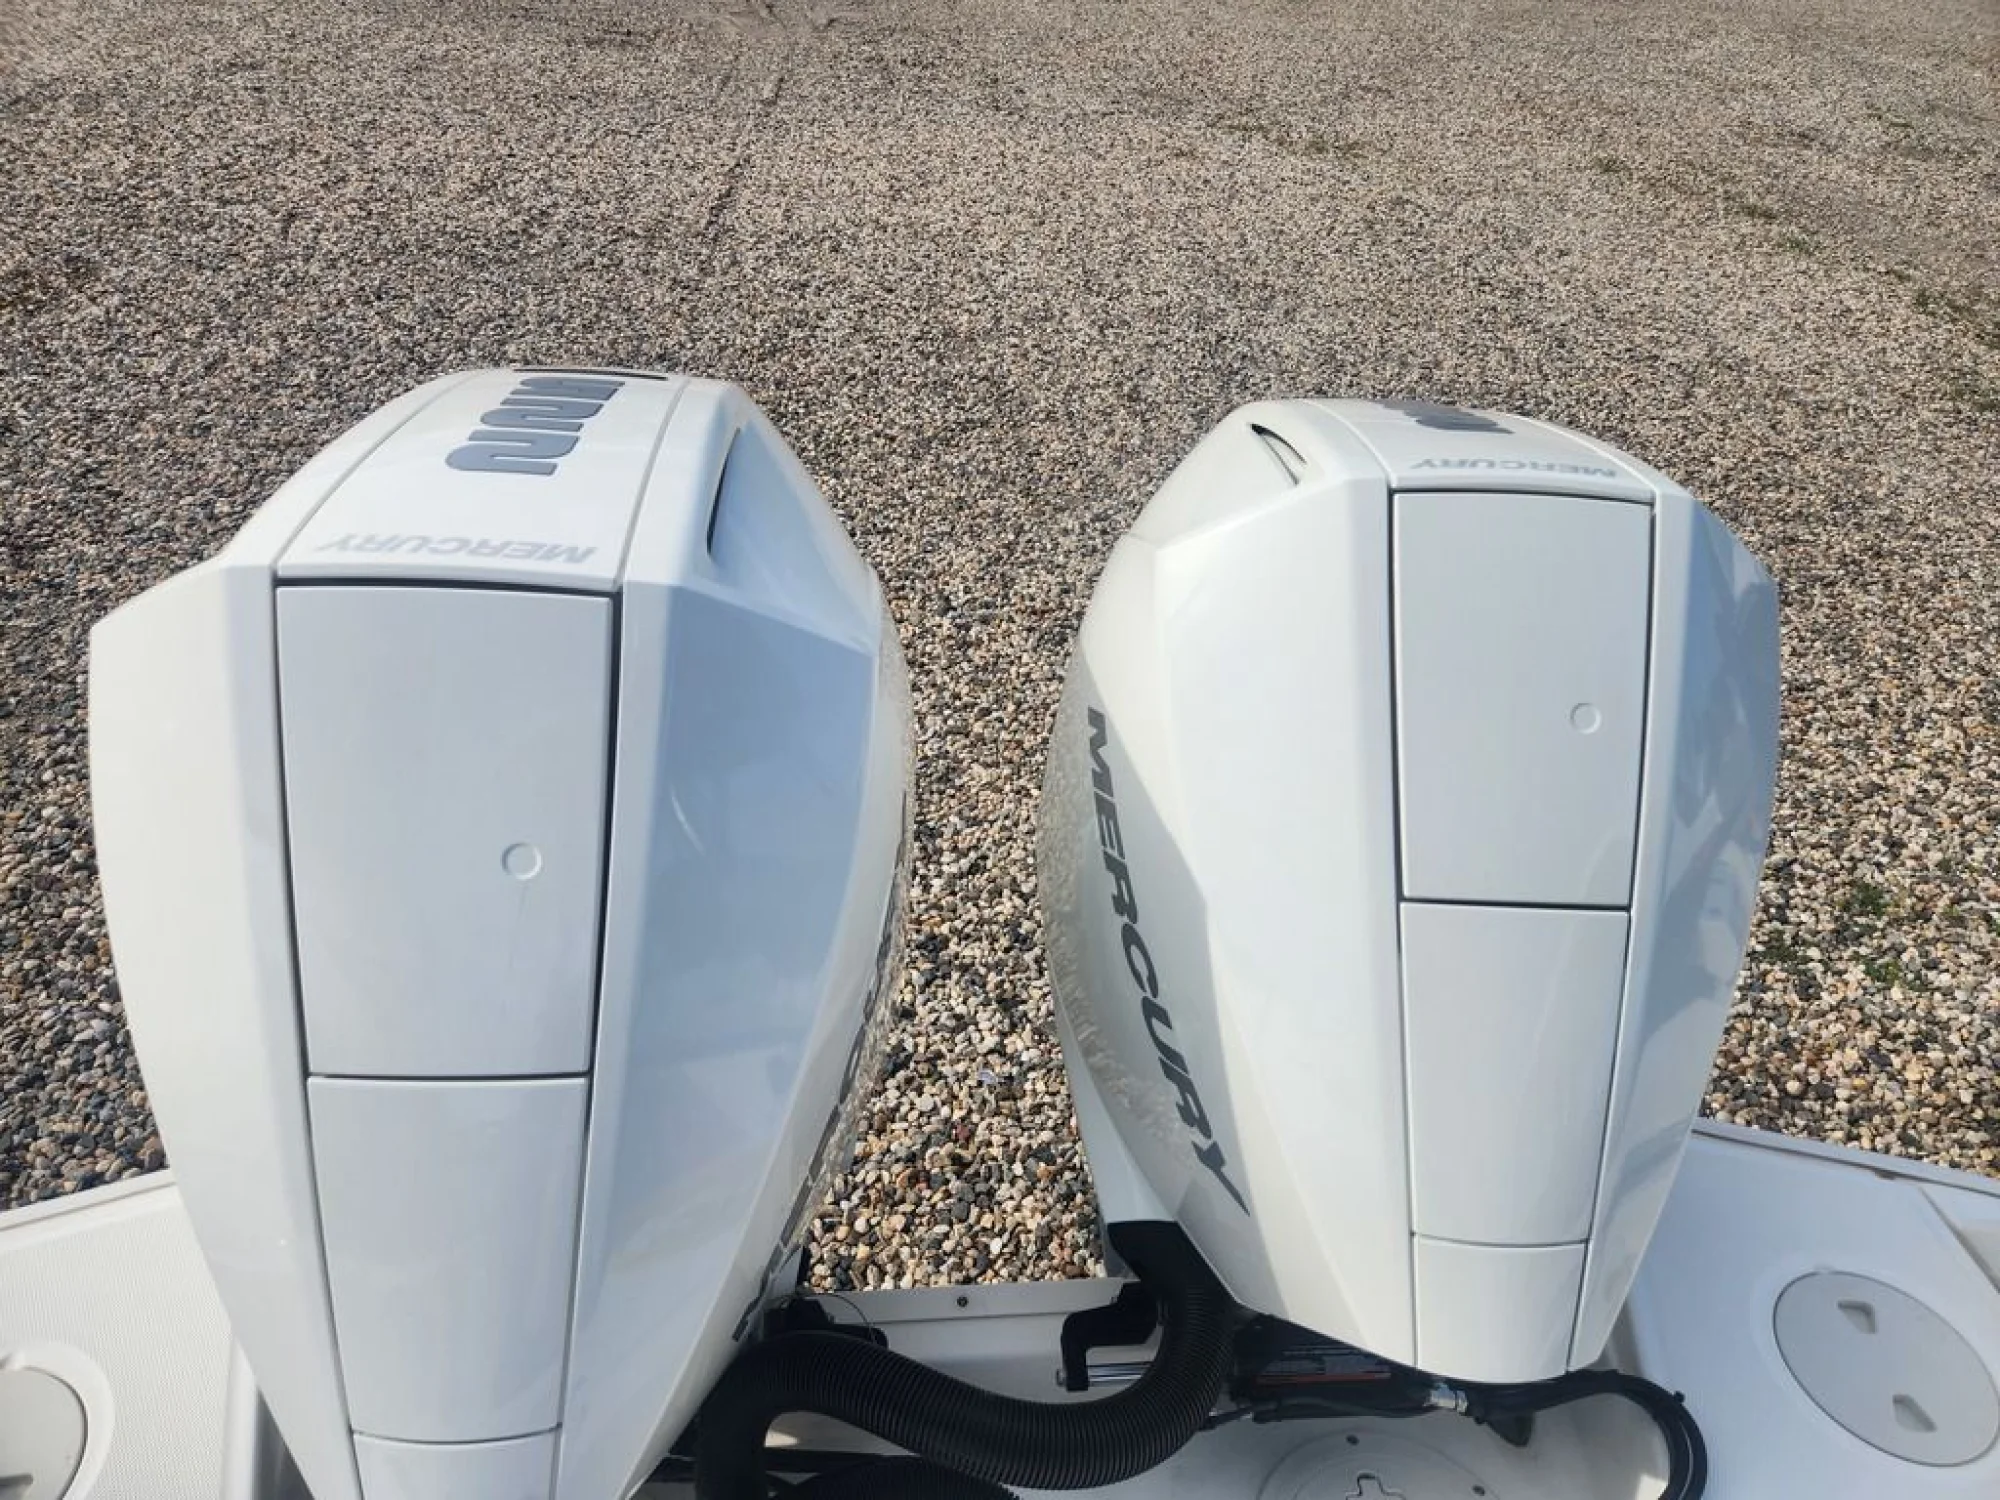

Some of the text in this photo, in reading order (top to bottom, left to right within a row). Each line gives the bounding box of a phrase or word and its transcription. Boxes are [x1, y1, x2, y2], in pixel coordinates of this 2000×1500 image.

[1411, 457, 1616, 477] MERCURY
[317, 532, 597, 564] MERCURY
[1088, 706, 1250, 1216] MERCURY
